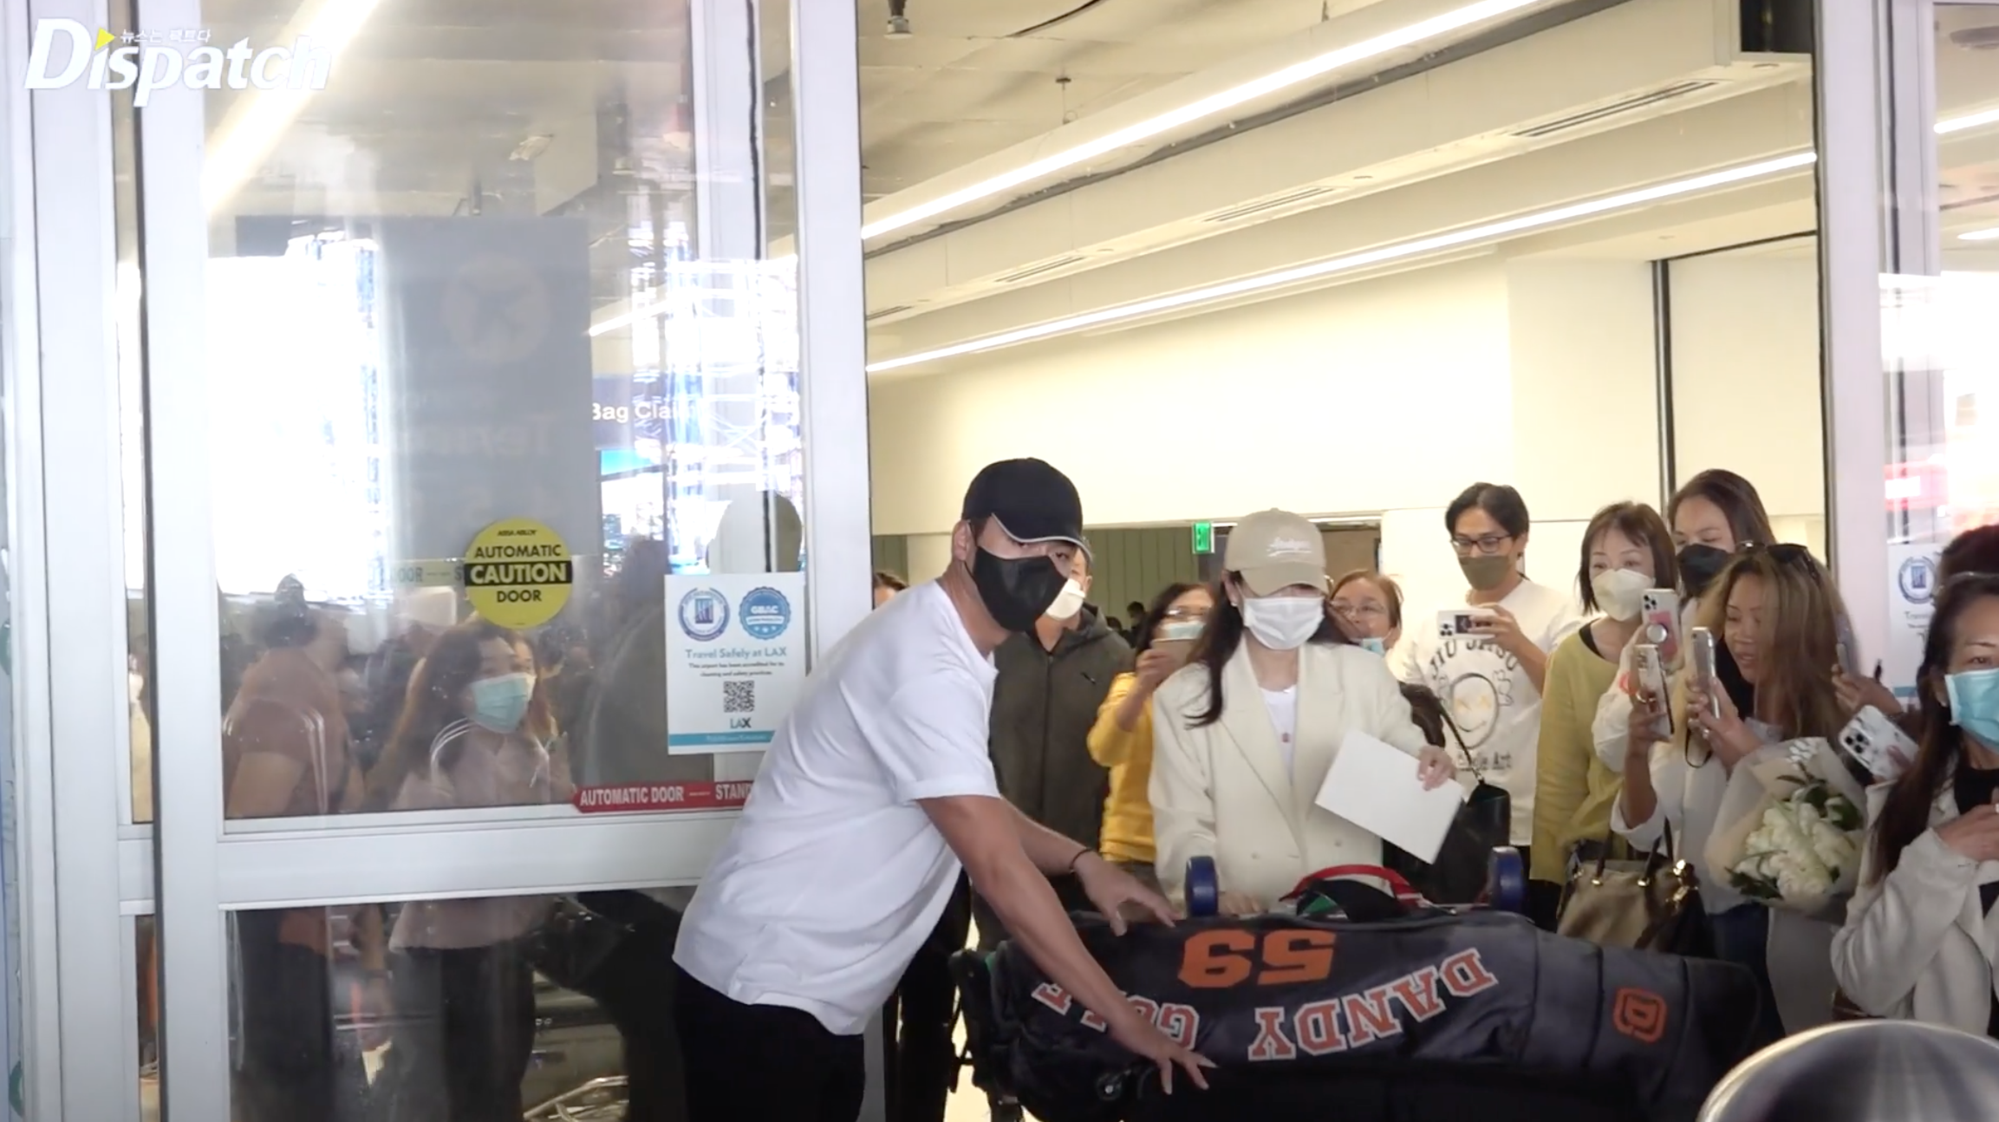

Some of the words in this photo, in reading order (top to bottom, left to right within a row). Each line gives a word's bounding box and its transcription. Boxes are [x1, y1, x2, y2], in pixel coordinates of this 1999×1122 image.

[592, 402, 629, 423] Bag
[474, 544, 562, 559] AUTOMATIC
[470, 563, 567, 584] CAUTION
[496, 590, 542, 603] DOOR
[685, 648, 717, 659] Travel
[719, 648, 750, 660] Safely
[752, 648, 762, 657] at
[764, 646, 787, 657] LAX
[730, 717, 752, 729] LAX
[580, 787, 649, 806] AUTOMATIC
[651, 786, 684, 803] DOOR
[1177, 928, 1336, 989] 59
[1247, 947, 1499, 1061] DANDY
